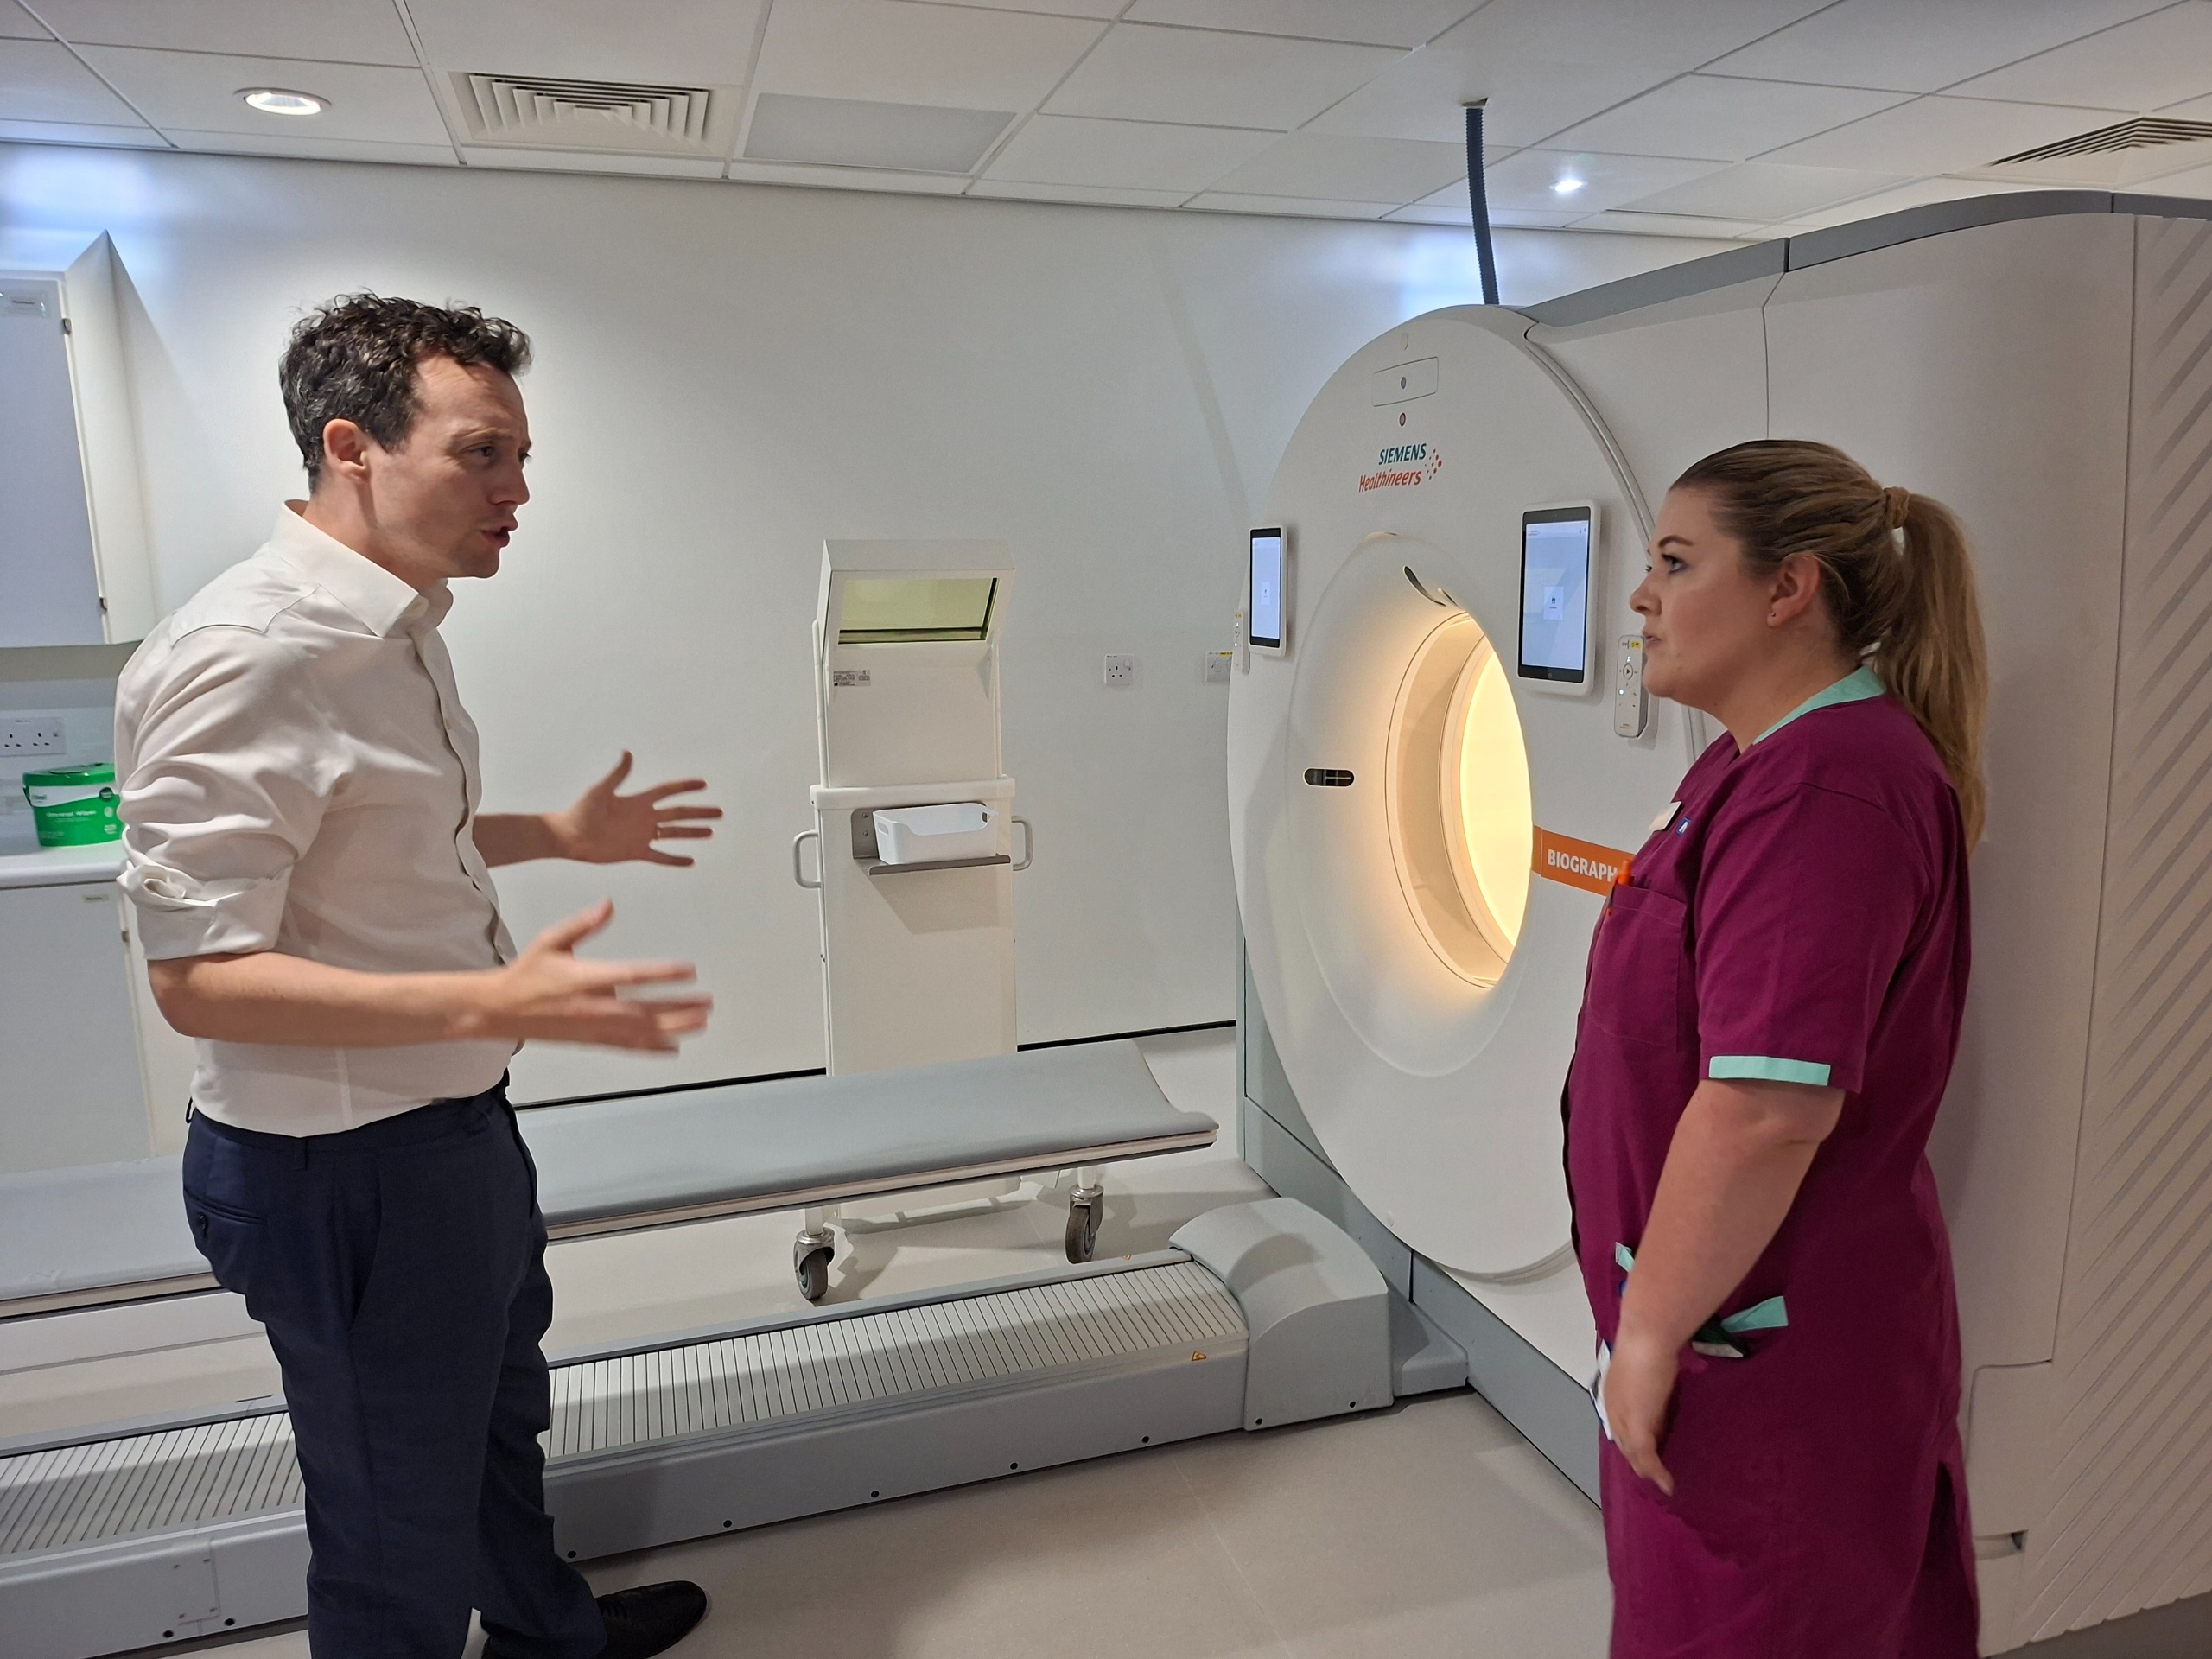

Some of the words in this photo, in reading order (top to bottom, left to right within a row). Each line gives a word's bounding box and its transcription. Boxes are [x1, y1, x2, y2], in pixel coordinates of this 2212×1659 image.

[1379, 443, 1427, 465] SIEMENS
[1358, 468, 1422, 493] Healthineers
[1548, 849, 1618, 882] BIOGRAPH
